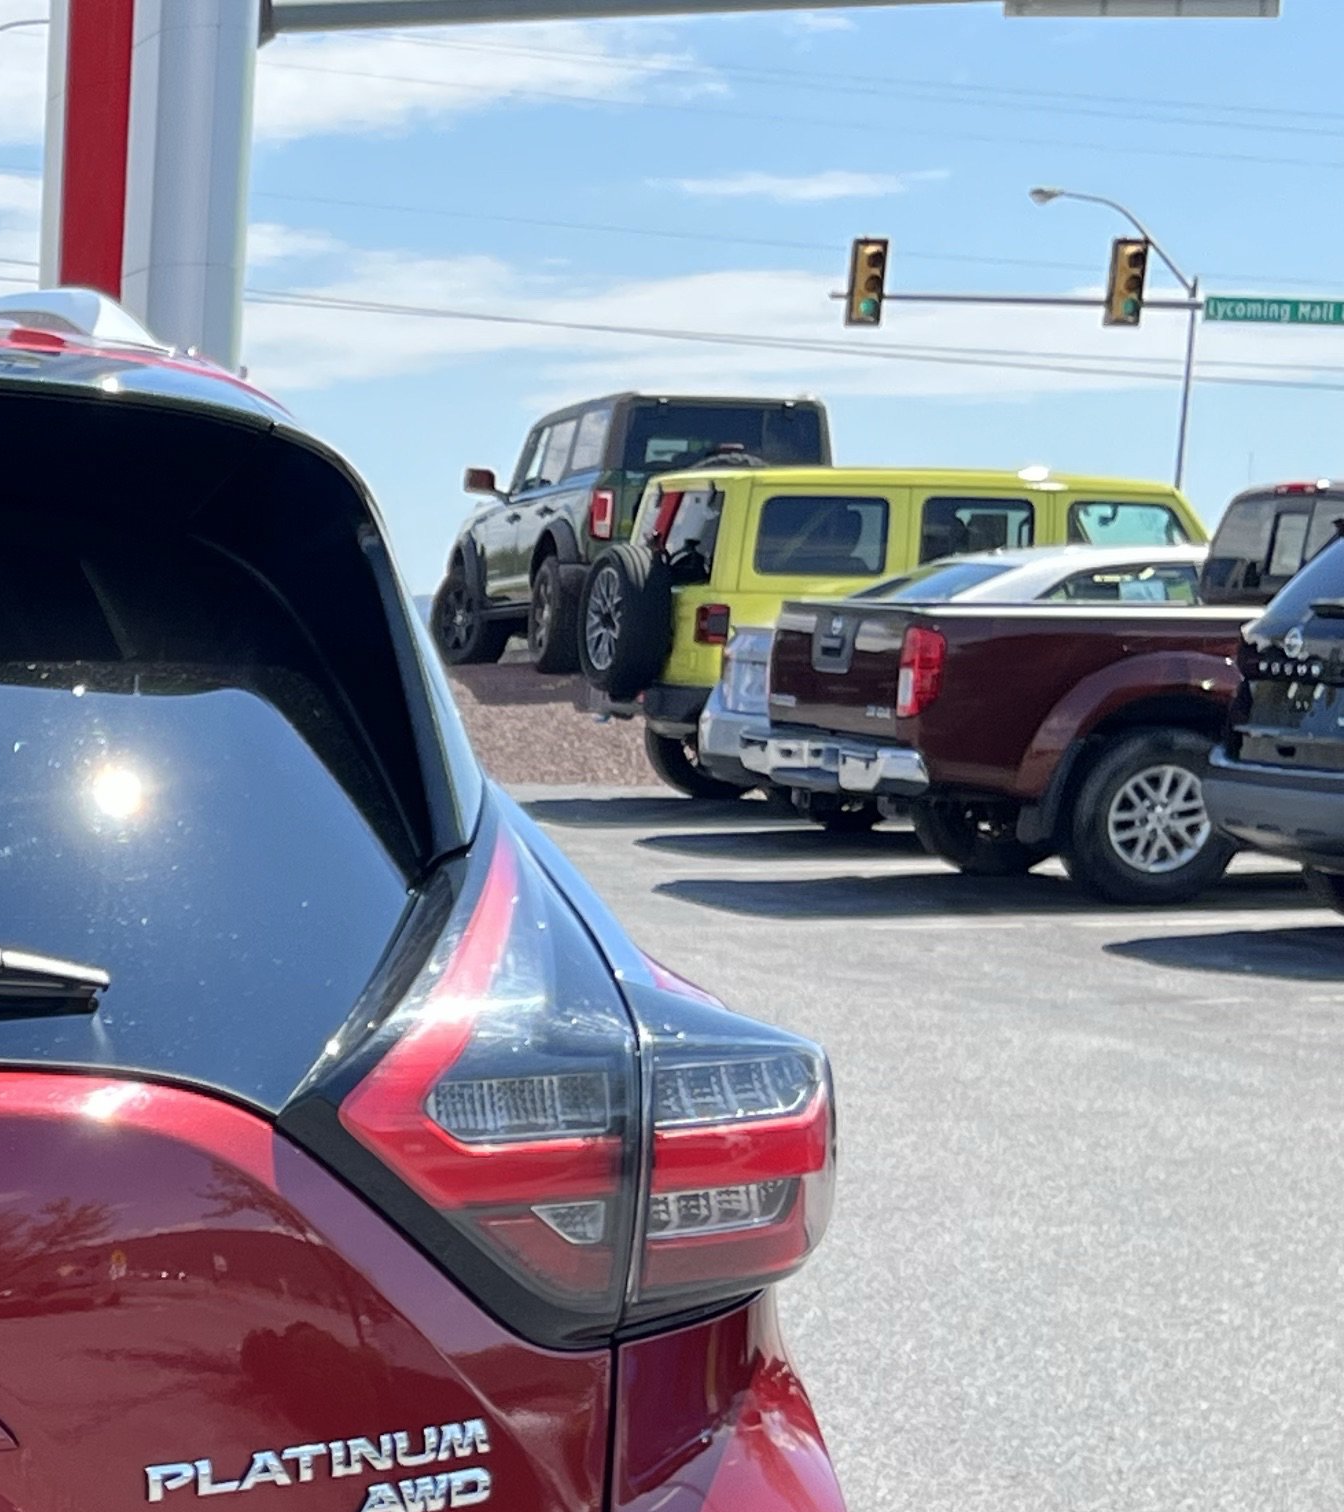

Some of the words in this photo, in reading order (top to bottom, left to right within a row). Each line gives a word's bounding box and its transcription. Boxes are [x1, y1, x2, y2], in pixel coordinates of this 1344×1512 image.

[1208, 301, 1291, 323] Lycoming
[1297, 303, 1334, 321] Mall
[144, 1418, 491, 1503] PLATINUM
